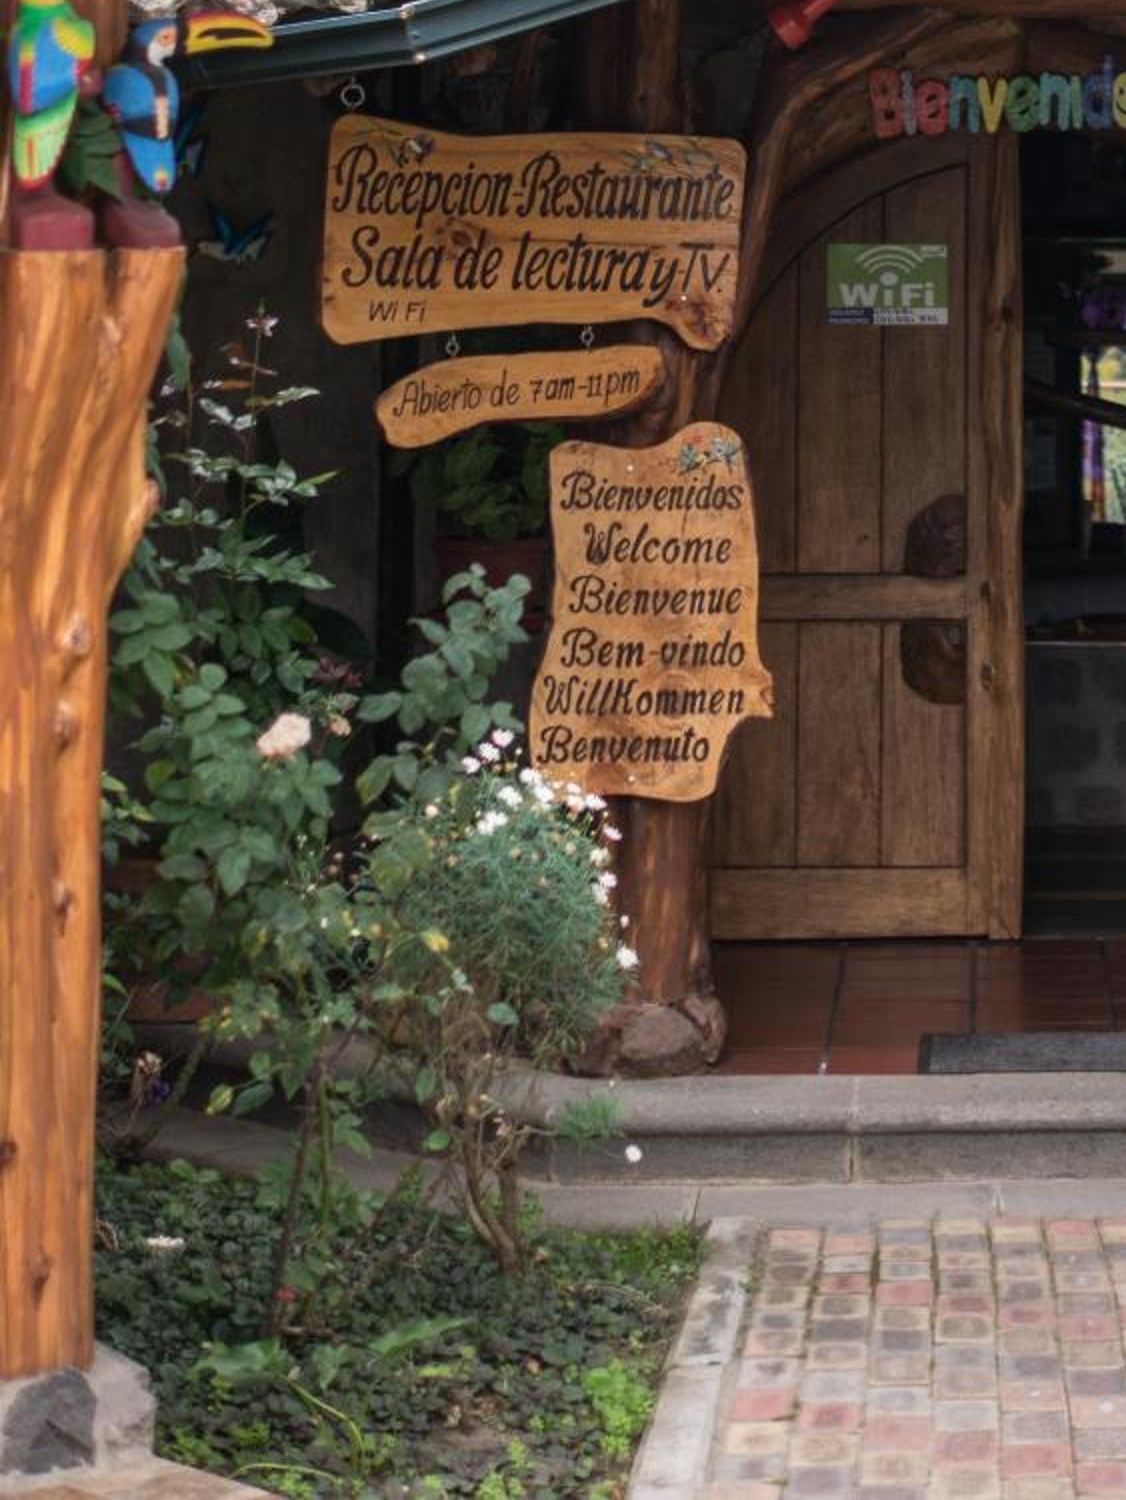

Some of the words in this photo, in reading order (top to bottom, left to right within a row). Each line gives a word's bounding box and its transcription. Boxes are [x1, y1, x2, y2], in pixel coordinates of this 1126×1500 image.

[341, 225, 446, 288] Sala
[453, 228, 502, 290] de
[512, 230, 650, 292] lectura
[840, 271, 936, 308] WiFi
[393, 381, 481, 416] Abierto
[489, 368, 520, 407] de
[560, 470, 744, 512] Bienvenidos
[584, 522, 732, 565] Welcome
[568, 575, 743, 617] Bienvenue
[536, 725, 710, 764] Benvenuto
